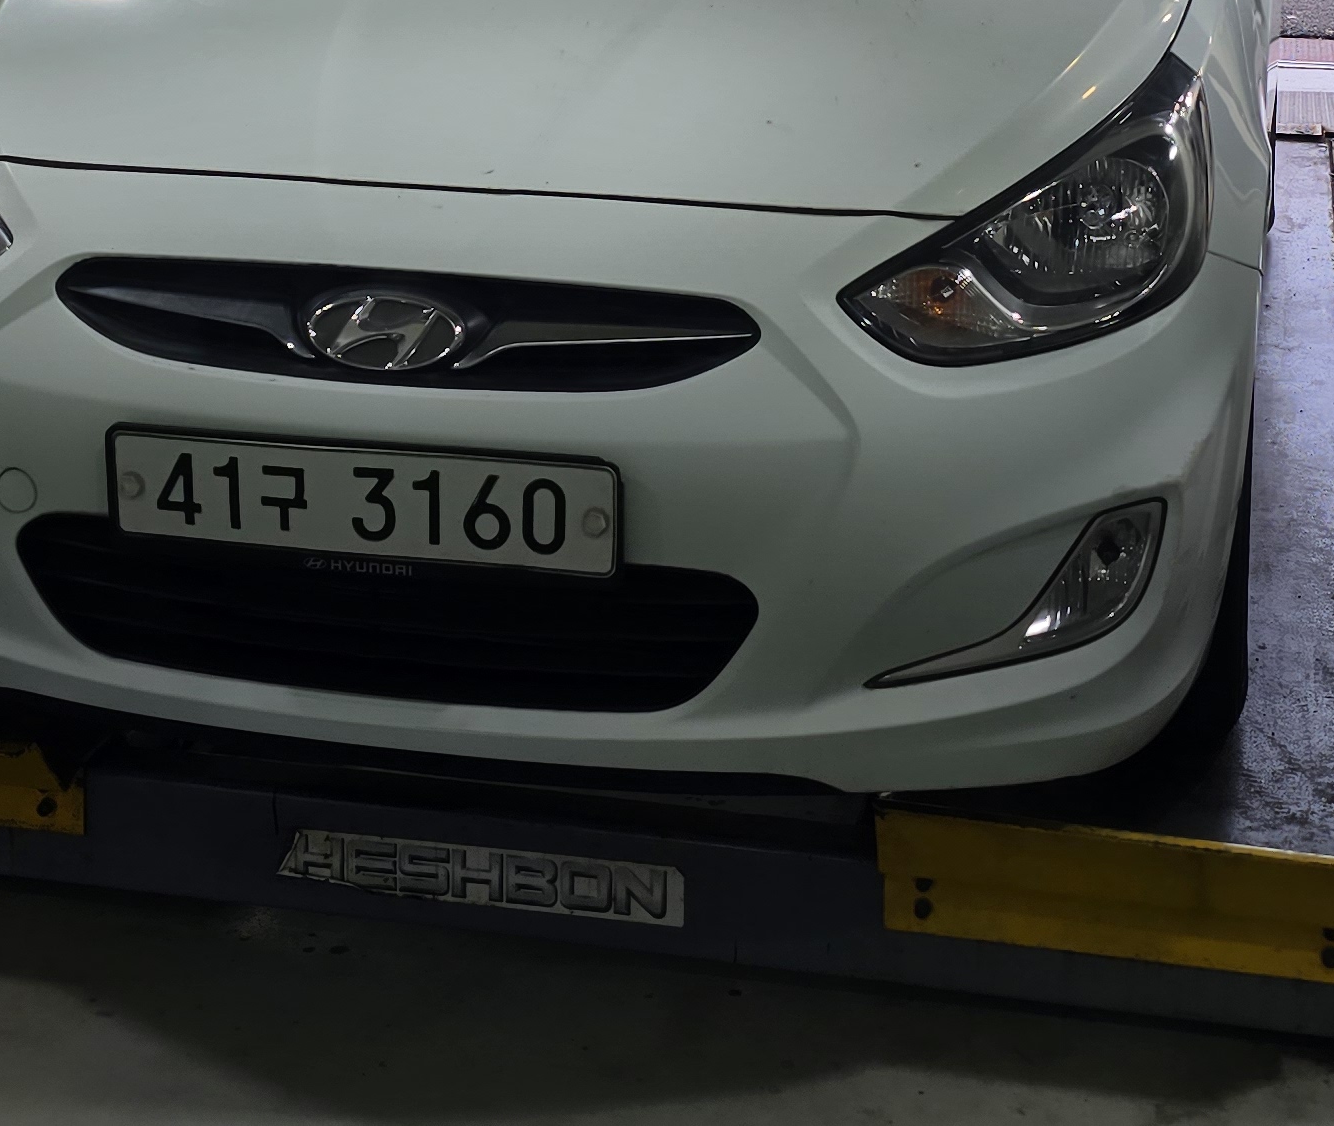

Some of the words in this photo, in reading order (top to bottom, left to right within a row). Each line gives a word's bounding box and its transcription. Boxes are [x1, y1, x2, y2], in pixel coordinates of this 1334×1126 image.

[157, 452, 307, 532] 41구
[351, 466, 566, 555] 3160
[330, 559, 412, 576] HYUNDAI
[293, 831, 668, 920] HESHBON
